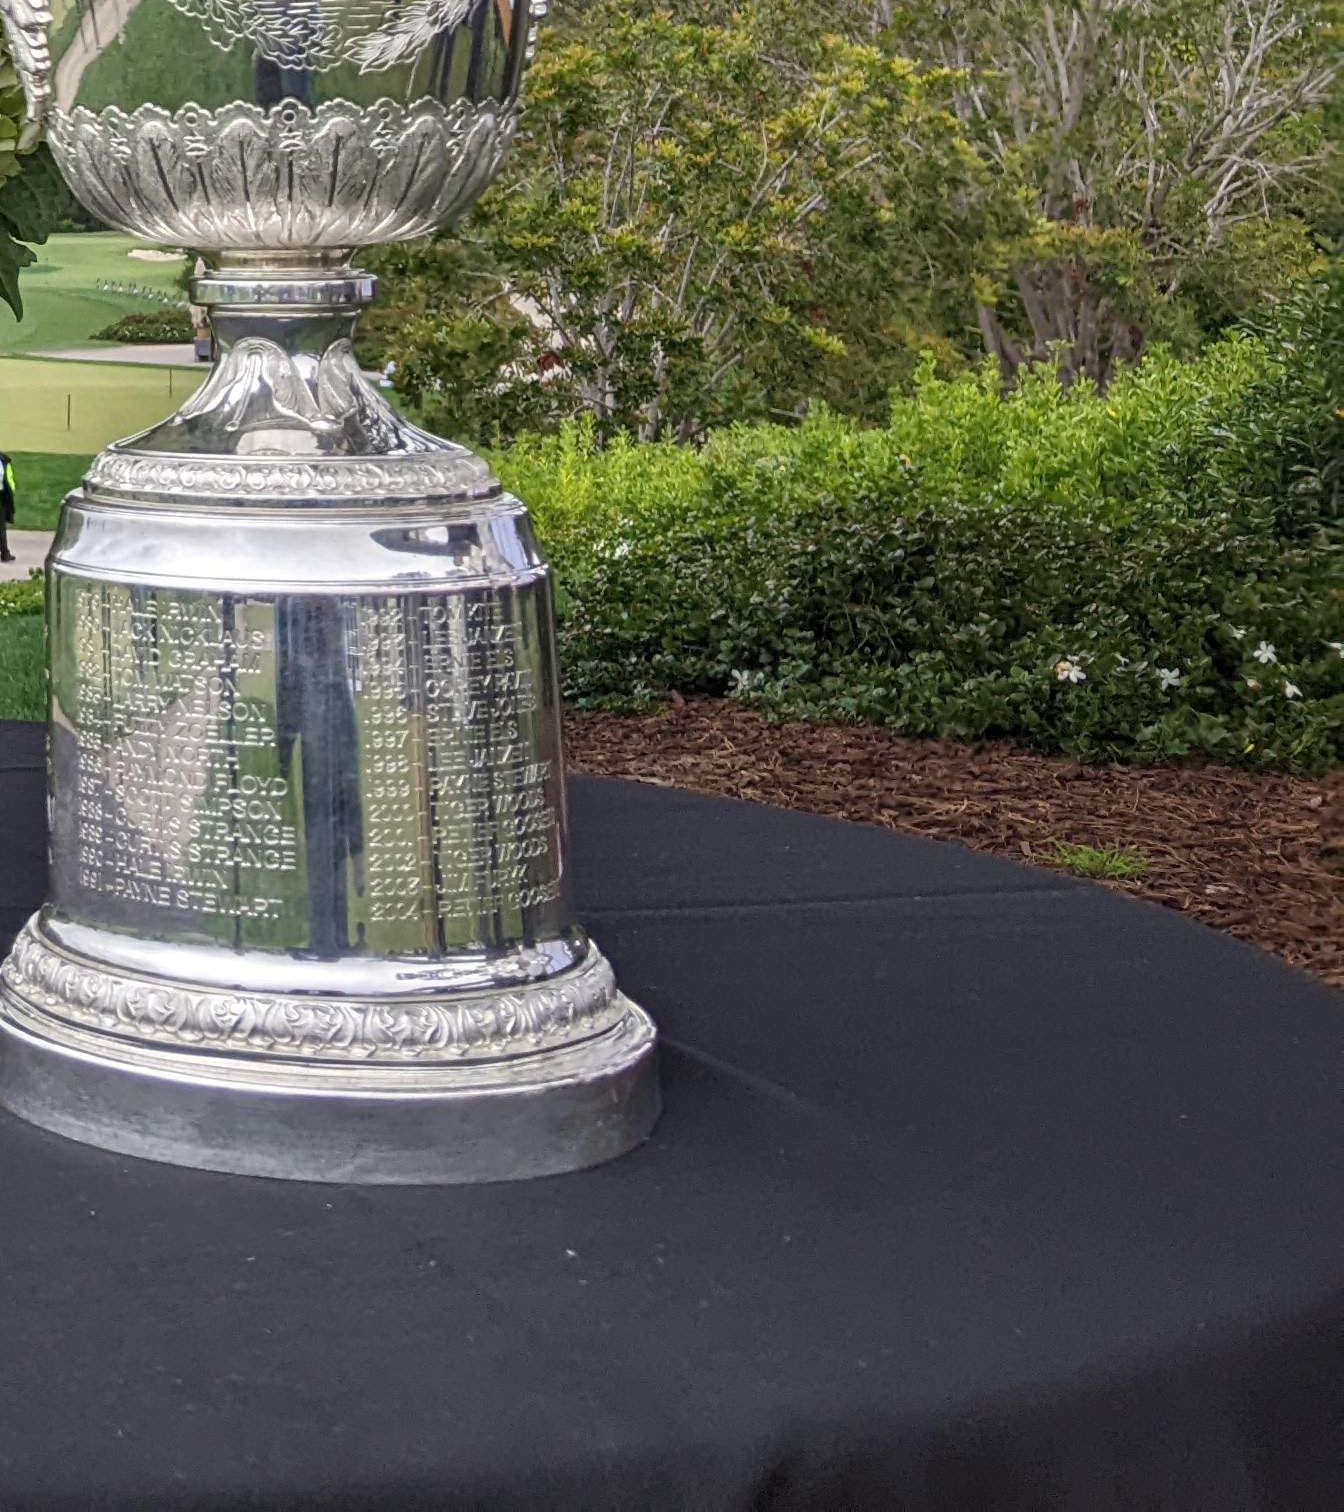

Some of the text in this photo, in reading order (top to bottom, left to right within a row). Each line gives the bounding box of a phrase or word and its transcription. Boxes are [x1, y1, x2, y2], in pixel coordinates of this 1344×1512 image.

[213, 772, 288, 797] FLOYD
[187, 818, 295, 845] STRANGE
[188, 842, 296, 870] STRANGE
[176, 889, 283, 918] STEWART
